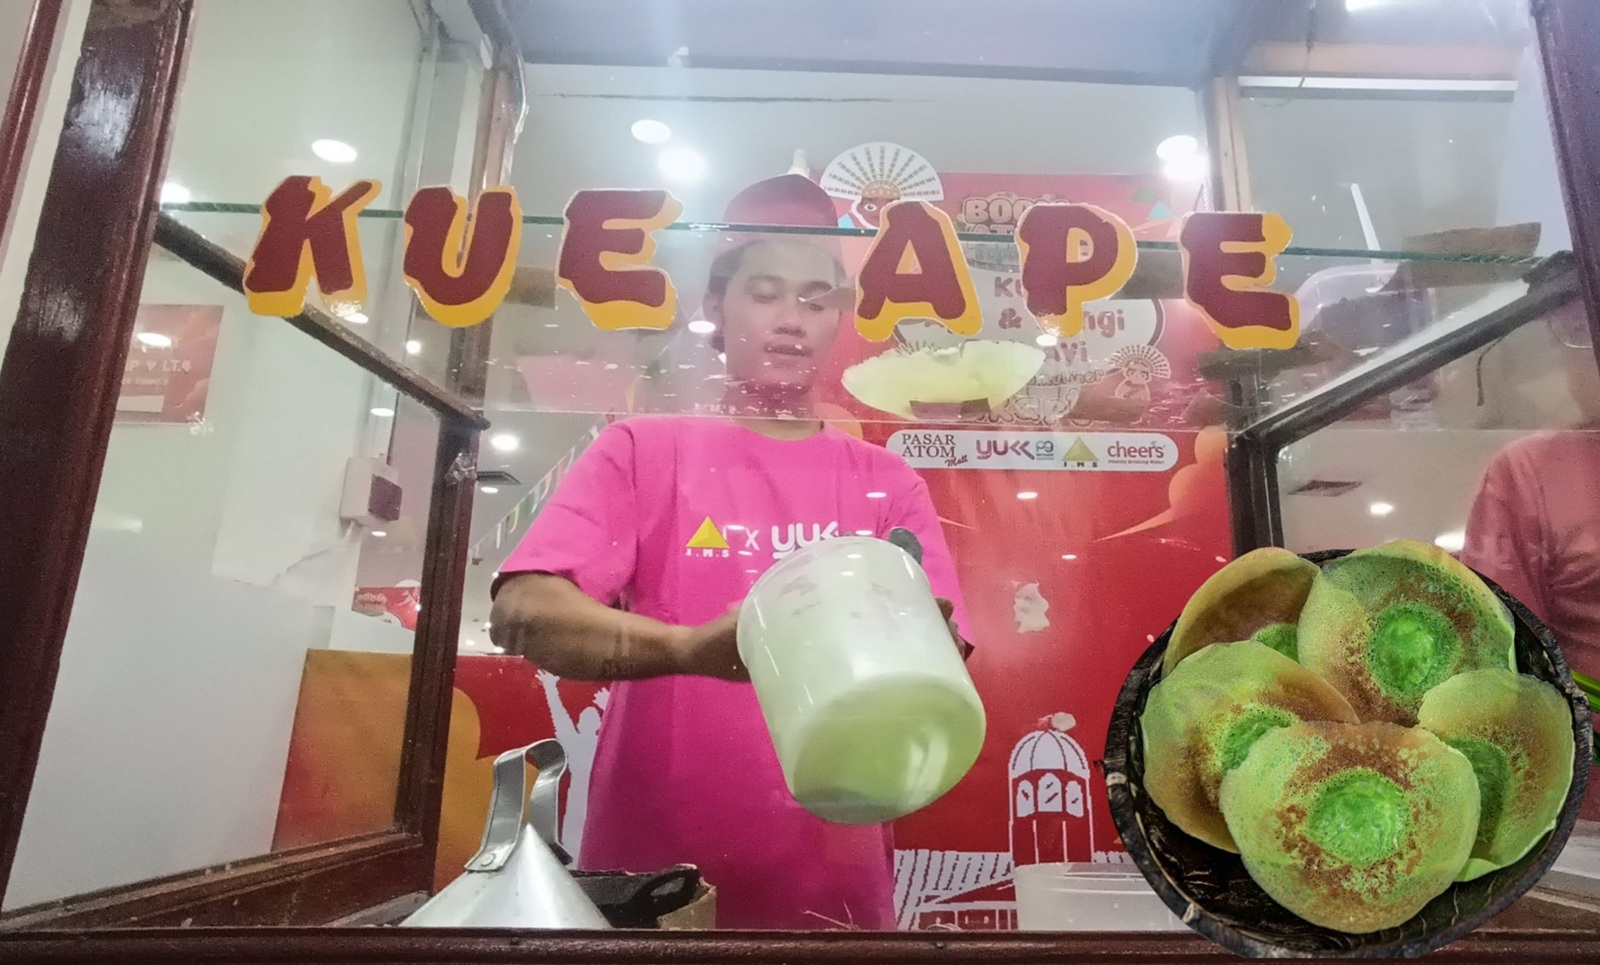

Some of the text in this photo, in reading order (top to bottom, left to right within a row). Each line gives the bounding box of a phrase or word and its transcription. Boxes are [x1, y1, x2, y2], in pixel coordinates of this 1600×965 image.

[243, 175, 1300, 351] KUE APE
[902, 433, 956, 445] PASAR
[902, 445, 956, 458] ATOM
[1107, 440, 1165, 459] cheers
